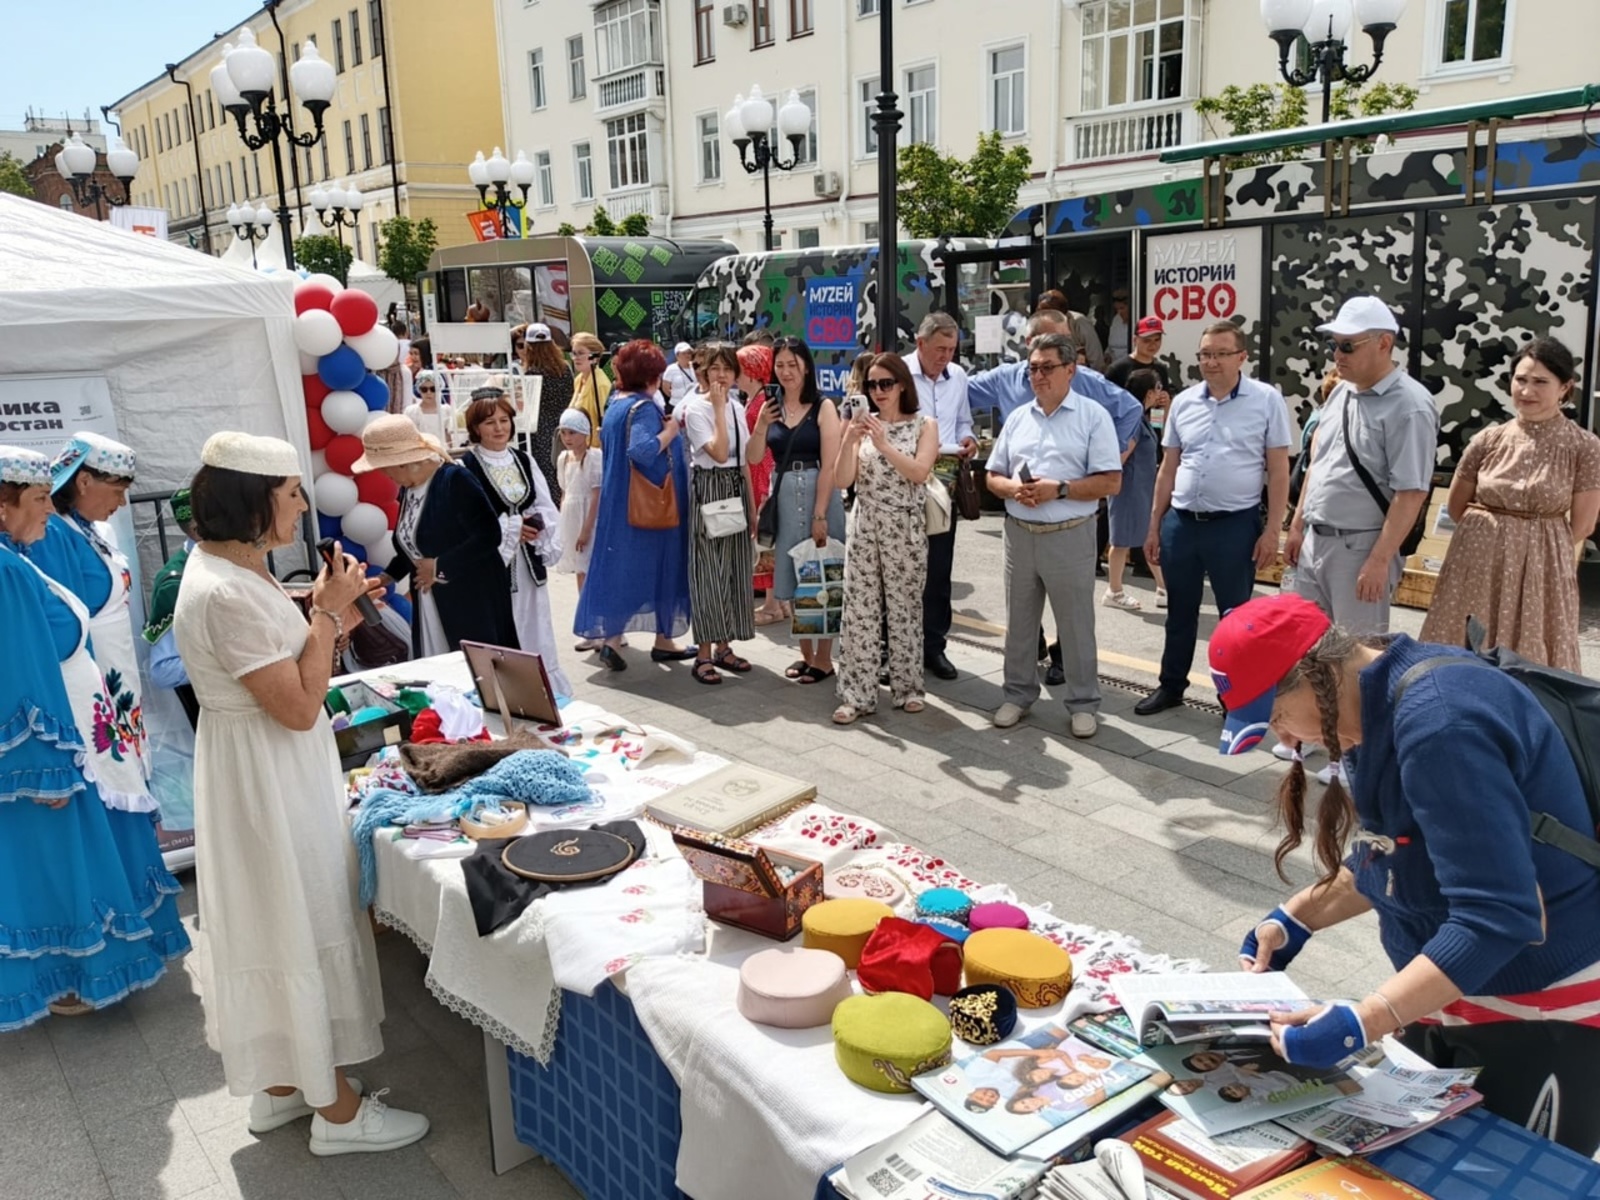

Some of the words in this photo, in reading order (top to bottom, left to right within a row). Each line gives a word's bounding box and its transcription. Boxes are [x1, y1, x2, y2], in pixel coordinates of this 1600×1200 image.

[1154, 264, 1235, 285] ИСТОРИИ
[809, 303, 852, 317] ИСТОРИИ
[1154, 283, 1236, 320] СВО
[808, 316, 853, 343] СВО
